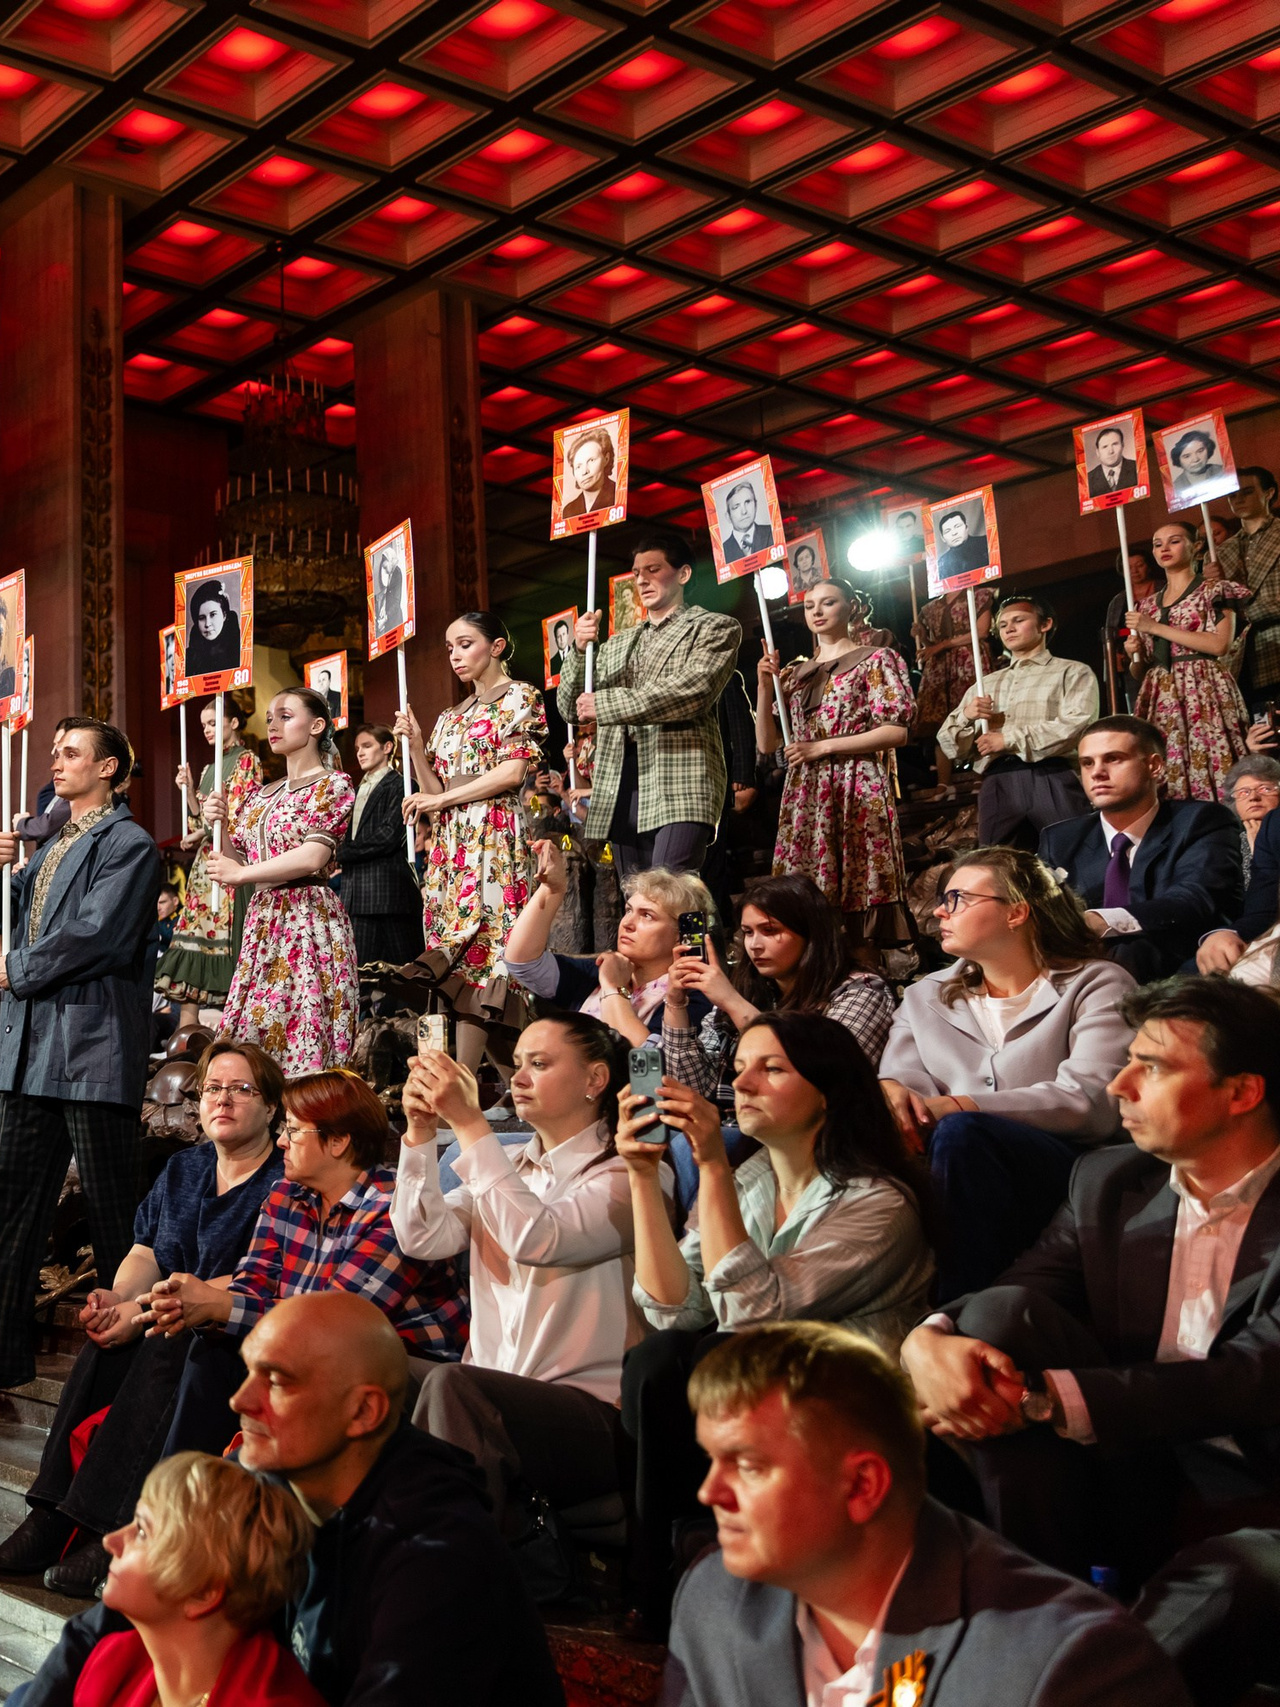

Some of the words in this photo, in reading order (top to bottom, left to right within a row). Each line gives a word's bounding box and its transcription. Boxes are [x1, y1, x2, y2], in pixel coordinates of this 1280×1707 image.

[1134, 486, 1147, 499] 80
[609, 507, 624, 522] 80
[771, 545, 784, 560] 80
[985, 566, 999, 580] 80
[404, 620, 413, 637] 80
[234, 670, 249, 686] 80
[11, 696, 21, 714] 80
